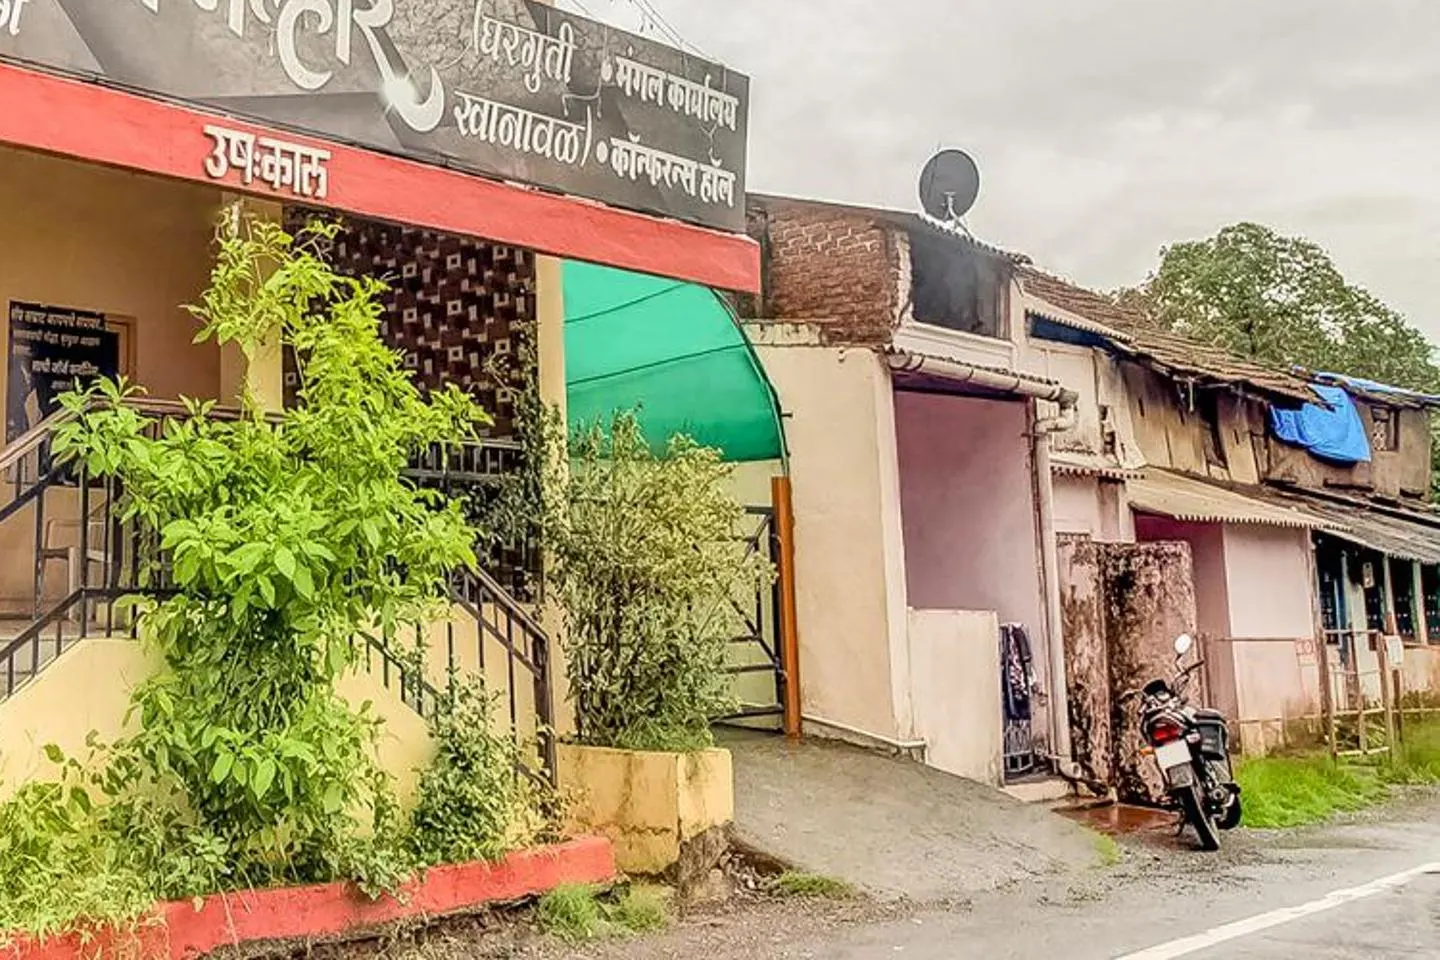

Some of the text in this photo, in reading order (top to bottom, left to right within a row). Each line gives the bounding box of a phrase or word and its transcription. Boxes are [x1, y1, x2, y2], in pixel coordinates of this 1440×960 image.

[616, 45, 739, 131] मंगल कार्यालय
[699, 158, 736, 207] हॉल
